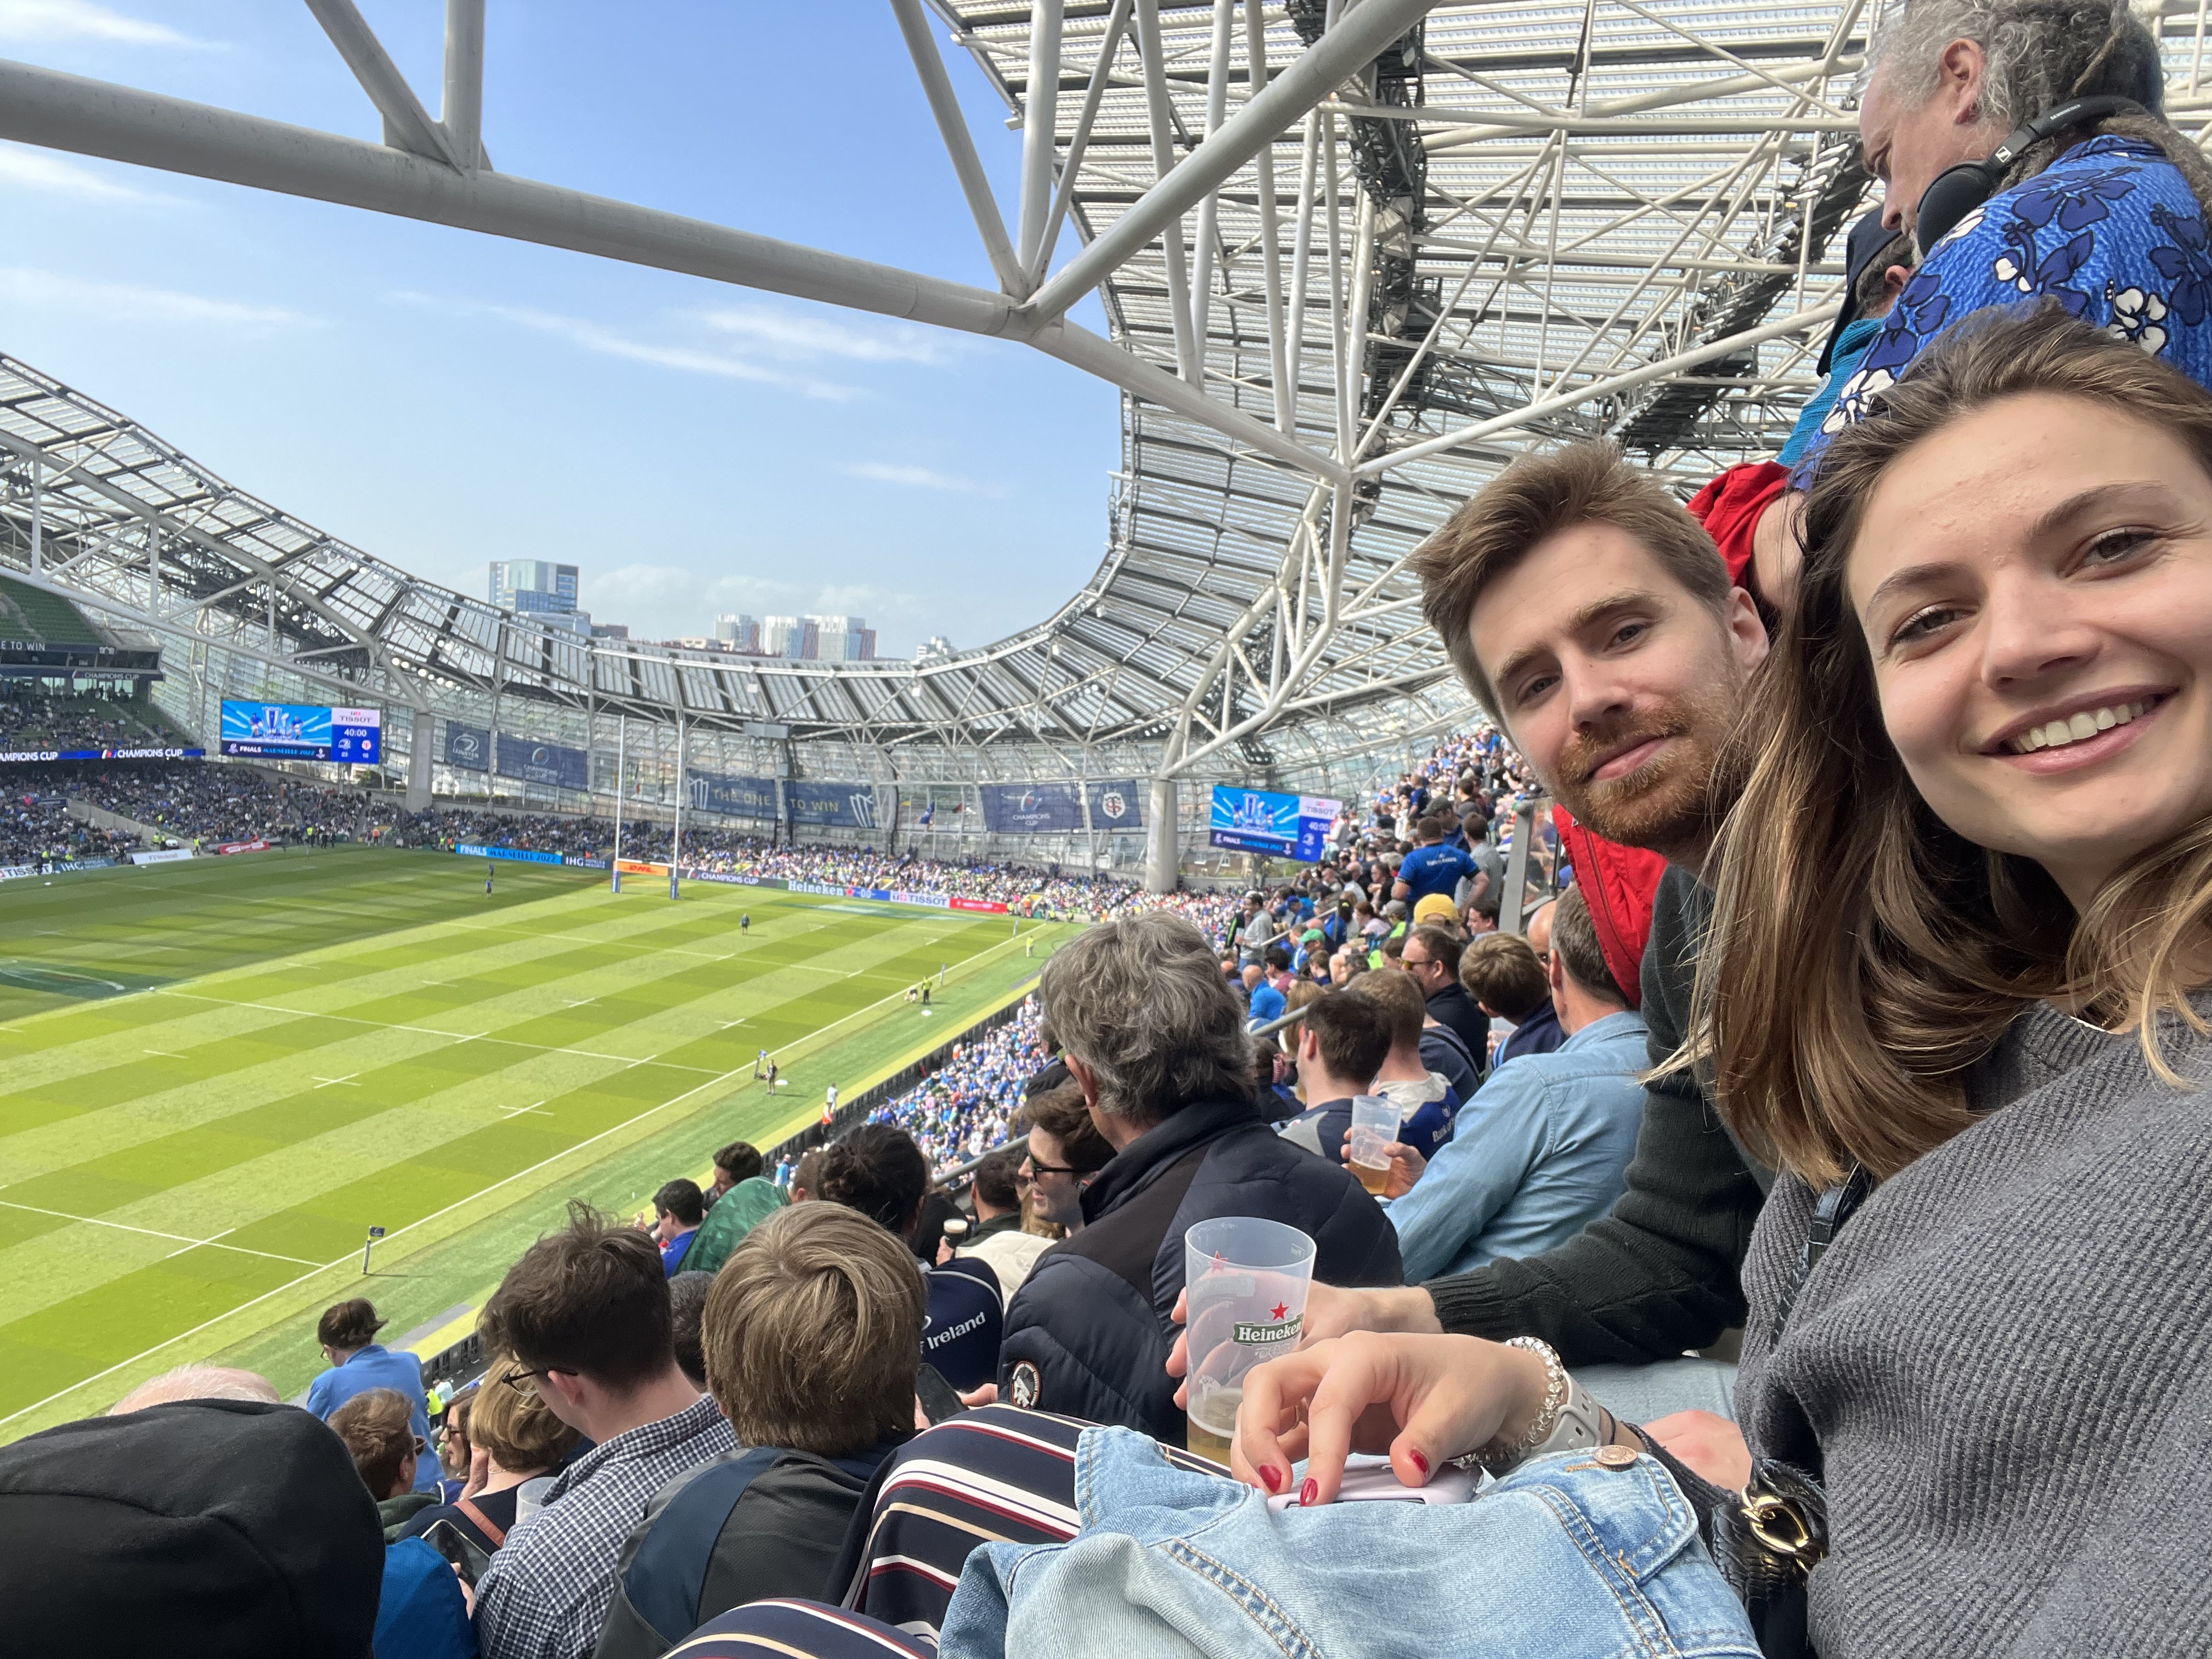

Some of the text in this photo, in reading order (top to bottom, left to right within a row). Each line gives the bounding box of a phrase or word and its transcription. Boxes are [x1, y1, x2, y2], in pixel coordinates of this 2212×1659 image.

[10, 641, 22, 651] TO
[26, 642, 45, 651] WIN
[344, 728, 367, 737] 40:00
[40, 751, 58, 761] CUP
[117, 748, 183, 758] CHAMPIONS CUP
[713, 788, 770, 806] THE ONE
[789, 798, 839, 812] TO WIN
[460, 844, 487, 856] FINALS
[60, 861, 83, 871] IHG
[566, 856, 584, 866] IHG
[4, 865, 49, 877] TISST
[701, 872, 743, 884] CHAMPIONS
[788, 880, 843, 896] Heineken
[907, 893, 948, 906] TISSOT
[927, 1311, 986, 1350] Ireland
[1238, 1320, 1302, 1342] Heineken
